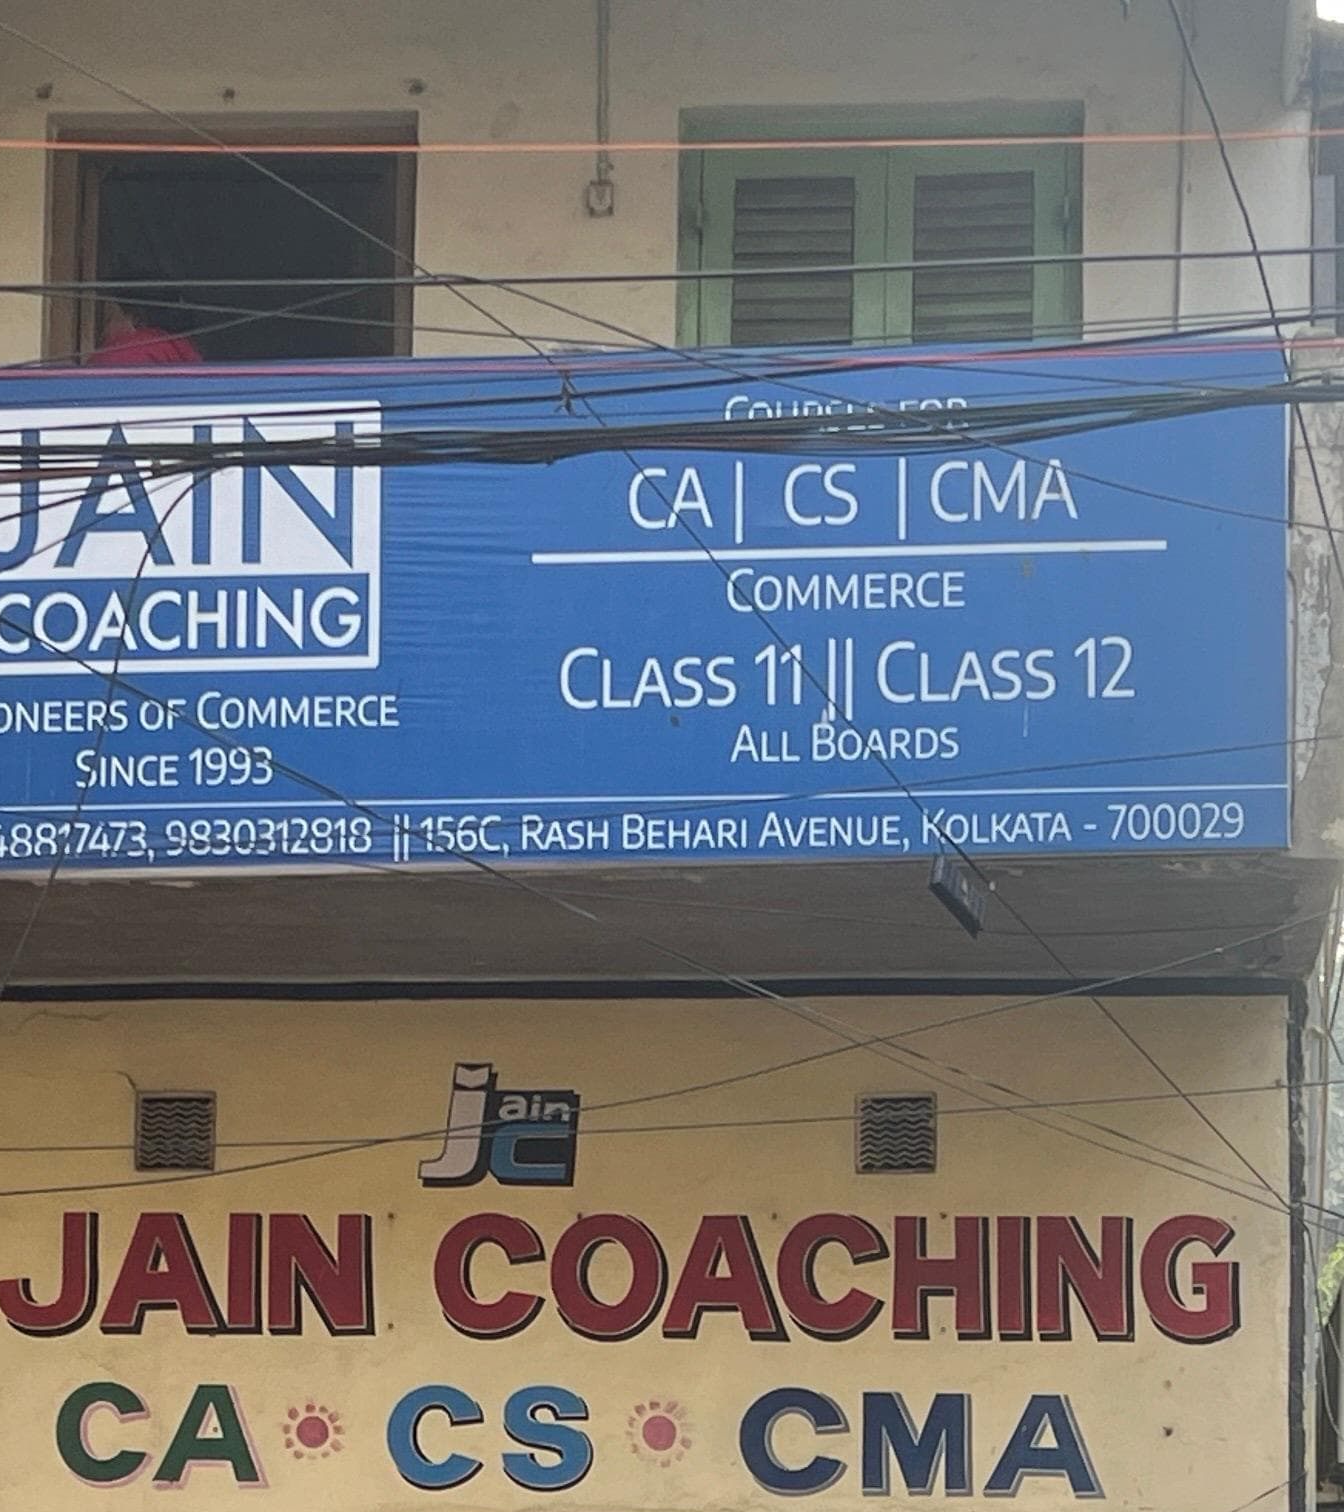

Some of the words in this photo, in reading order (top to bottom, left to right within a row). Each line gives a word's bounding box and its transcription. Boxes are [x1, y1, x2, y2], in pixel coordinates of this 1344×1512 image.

[627, 467, 713, 531] CA
[784, 463, 858, 527] CS
[930, 458, 1079, 524] CMA
[754, 644, 803, 706] 11
[1073, 636, 1136, 700] 12
[139, 697, 186, 732] OF
[731, 723, 800, 763] ALL
[188, 746, 274, 787] 1993
[166, 815, 373, 857] 9830312818
[424, 815, 510, 859] 156C,
[1108, 803, 1245, 842] 700029
[433, 1212, 1241, 1343] COACHING
[55, 1381, 267, 1491] CA
[386, 1382, 593, 1493] CS
[738, 1386, 1105, 1500] CMA
